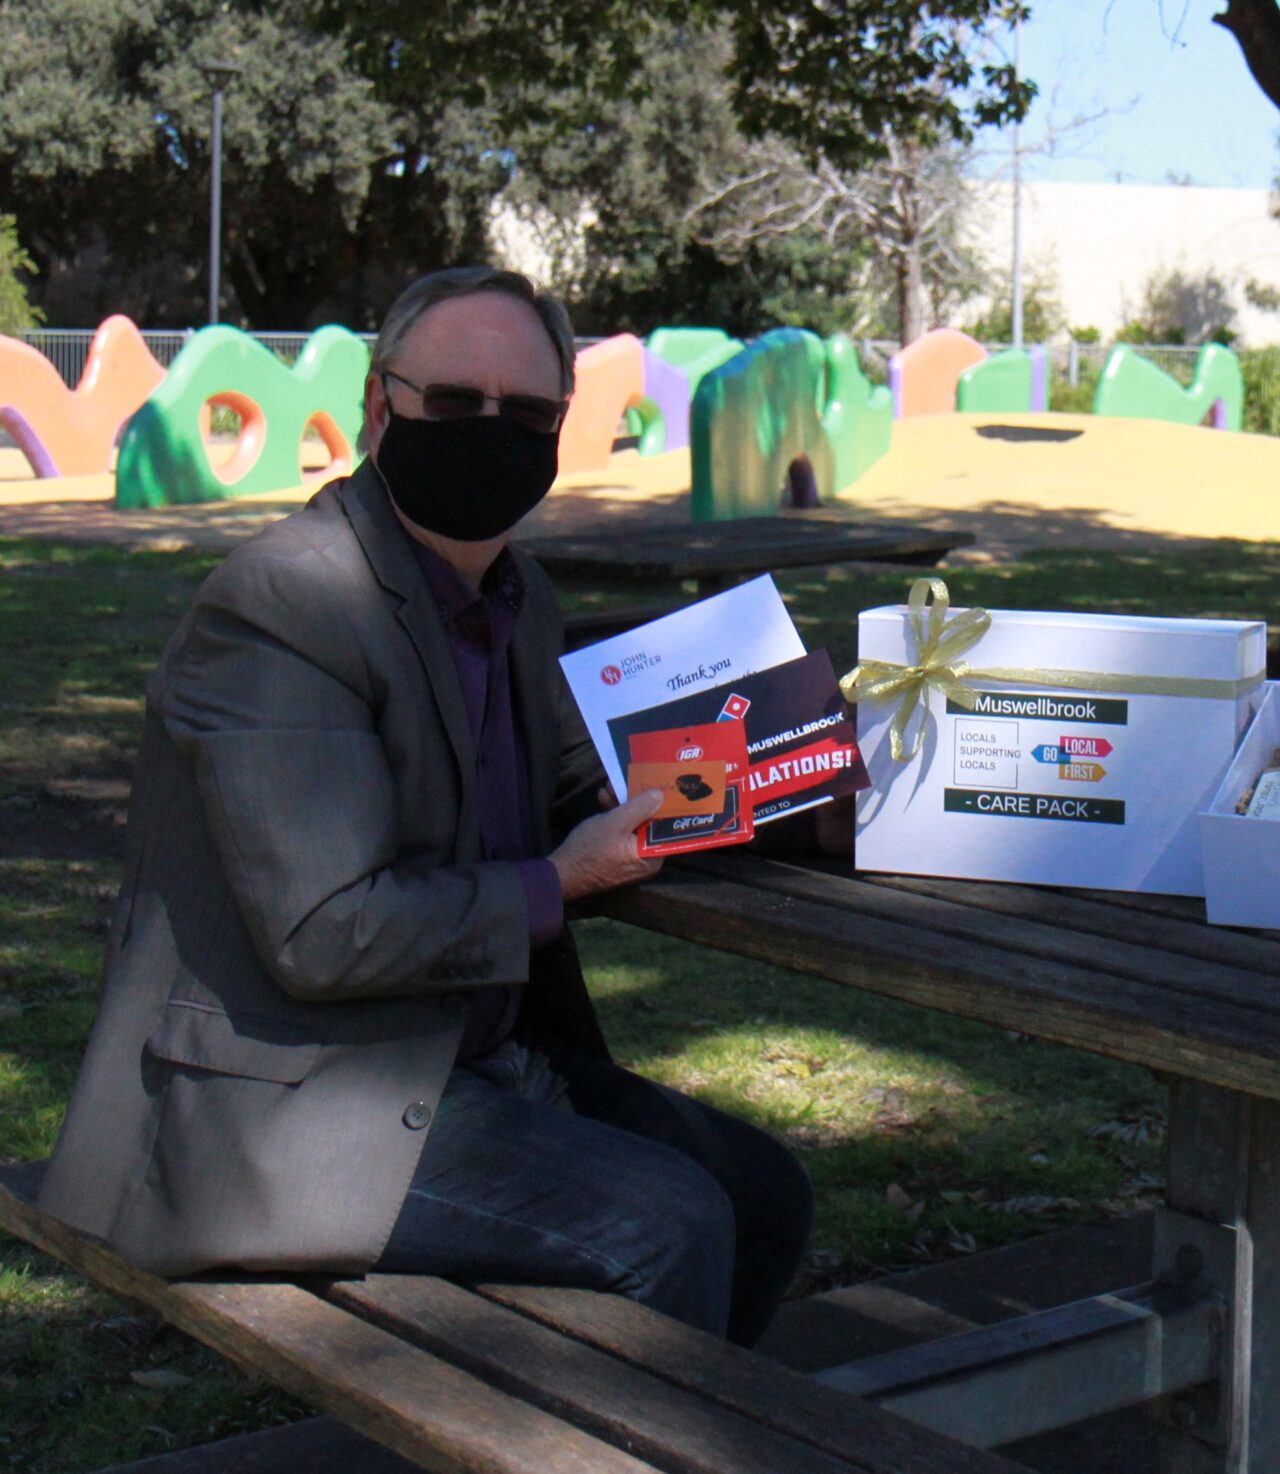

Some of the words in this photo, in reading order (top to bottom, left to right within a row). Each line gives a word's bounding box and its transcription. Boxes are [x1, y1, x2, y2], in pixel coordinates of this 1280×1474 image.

[620, 652, 647, 668] JOHN
[622, 655, 662, 676] HUNTER
[666, 664, 709, 691] Thank
[704, 657, 732, 679] you
[974, 695, 1096, 719] Muswellbrook
[747, 712, 845, 755] MUSWELLBROOK
[960, 732, 996, 743] LOCALS
[679, 747, 701, 762] IGA
[960, 746, 1021, 759] SUPPORTING
[1043, 747, 1058, 762] GO
[1065, 738, 1098, 755] LOCAL
[960, 760, 996, 771] LOCALS
[1064, 764, 1095, 779] FIRST
[777, 800, 791, 810] TO
[977, 795, 1030, 814] CARE
[1036, 798, 1089, 818] PACK
[672, 815, 690, 830] Gift
[692, 812, 715, 826] Card
